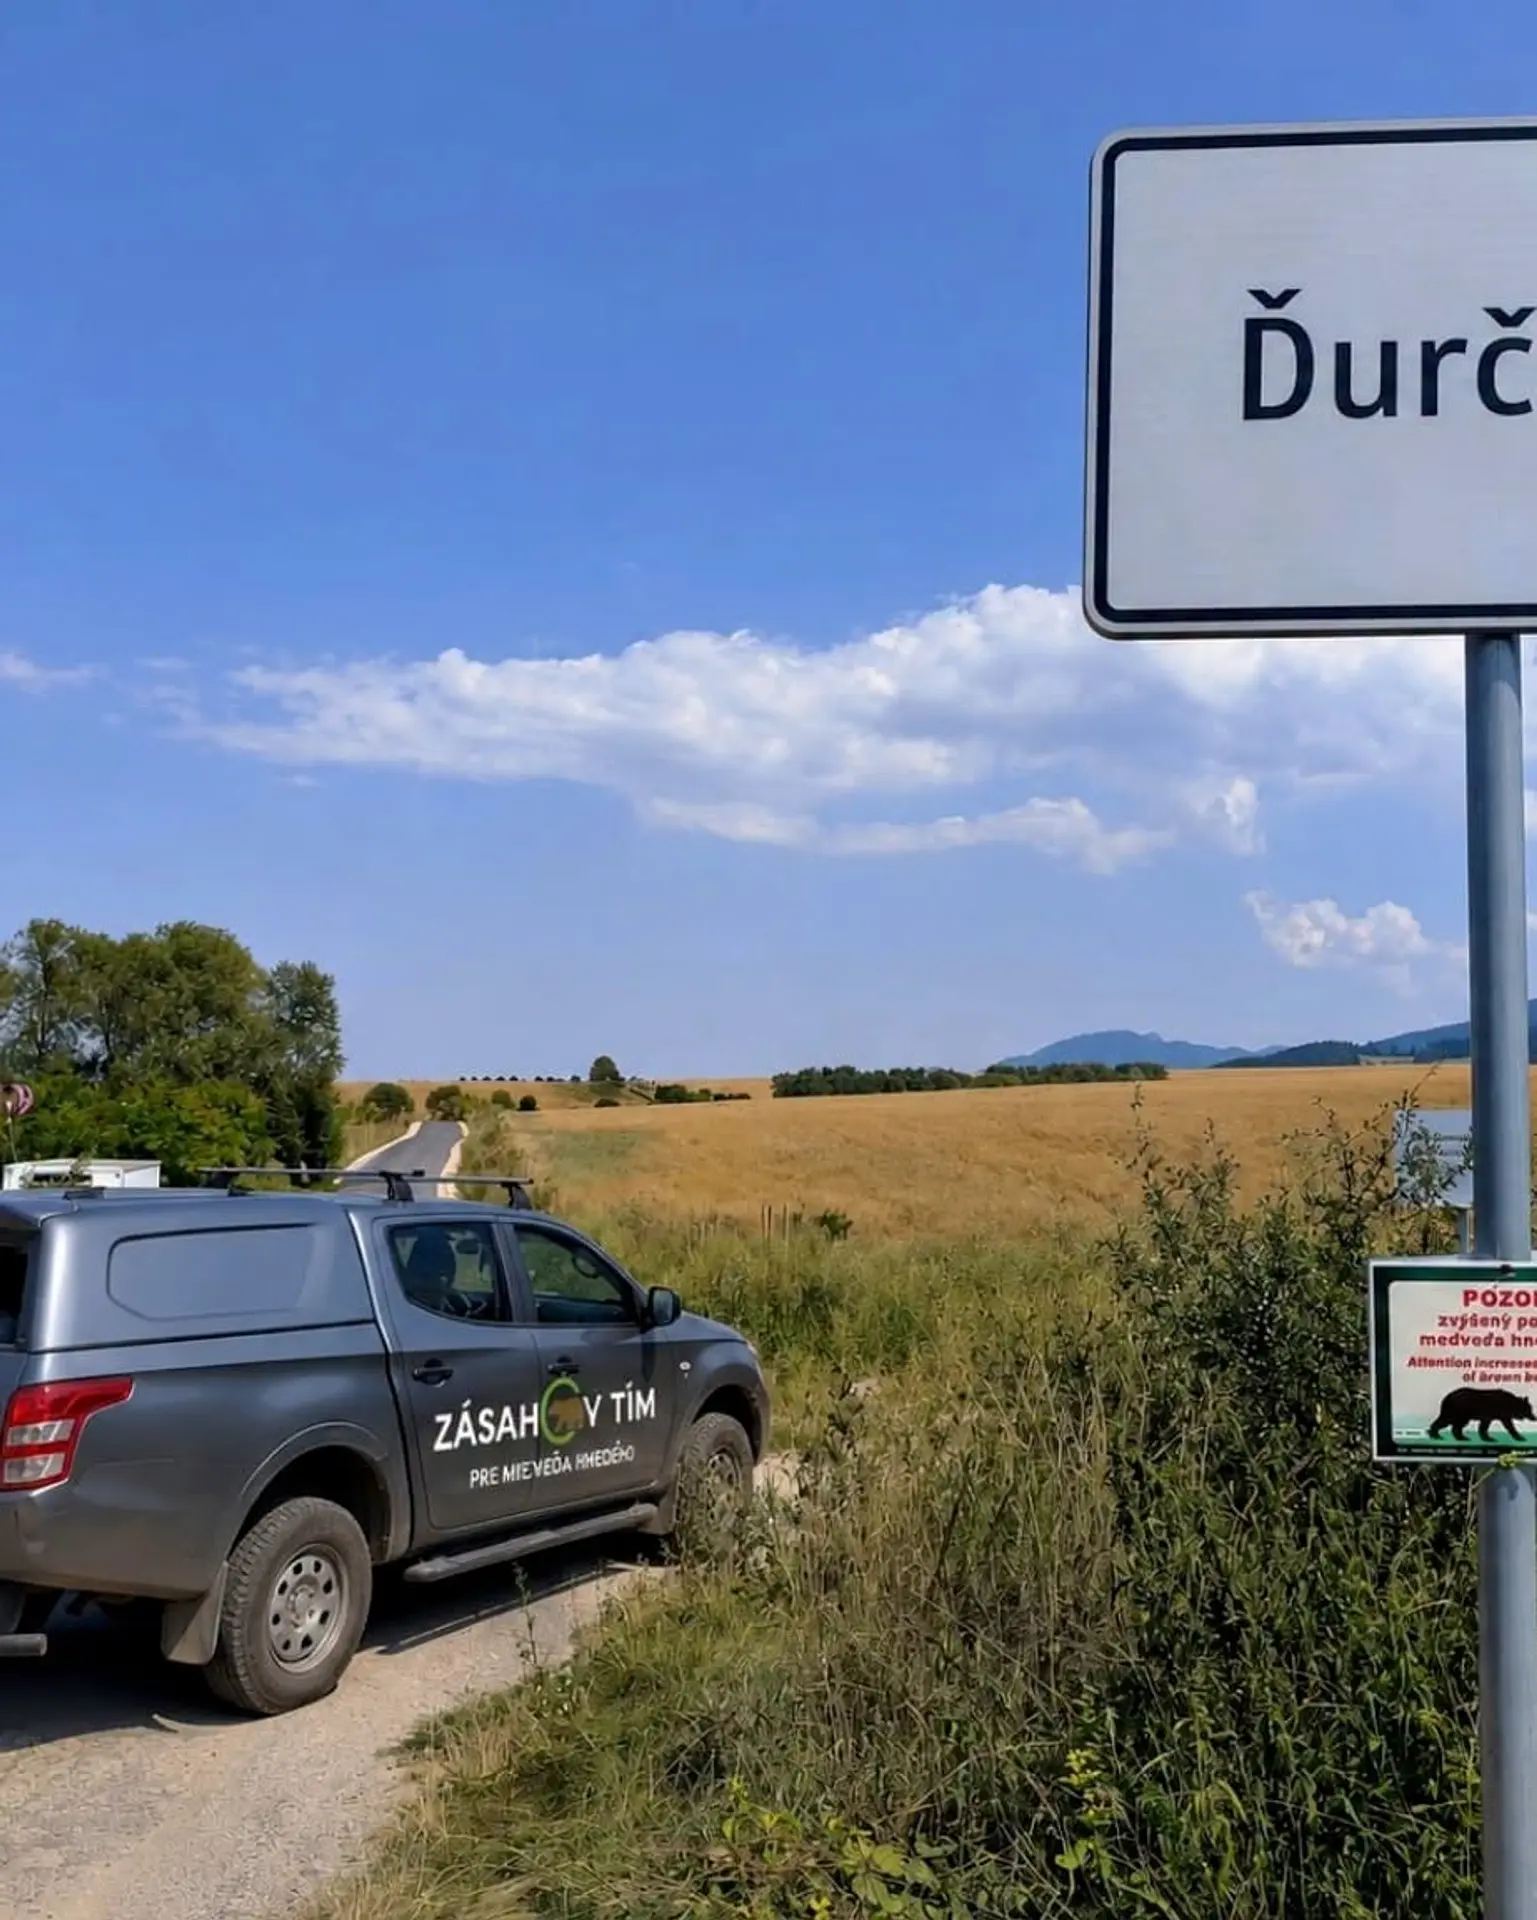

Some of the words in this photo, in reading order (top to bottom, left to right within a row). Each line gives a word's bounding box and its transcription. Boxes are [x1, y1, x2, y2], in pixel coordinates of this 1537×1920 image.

[1243, 288, 1537, 421] Ďurč
[1463, 1289, 1537, 1308] POZO
[1511, 1333, 1537, 1347] hn
[610, 1380, 656, 1424] TÍM
[470, 1466, 499, 1489] PRE
